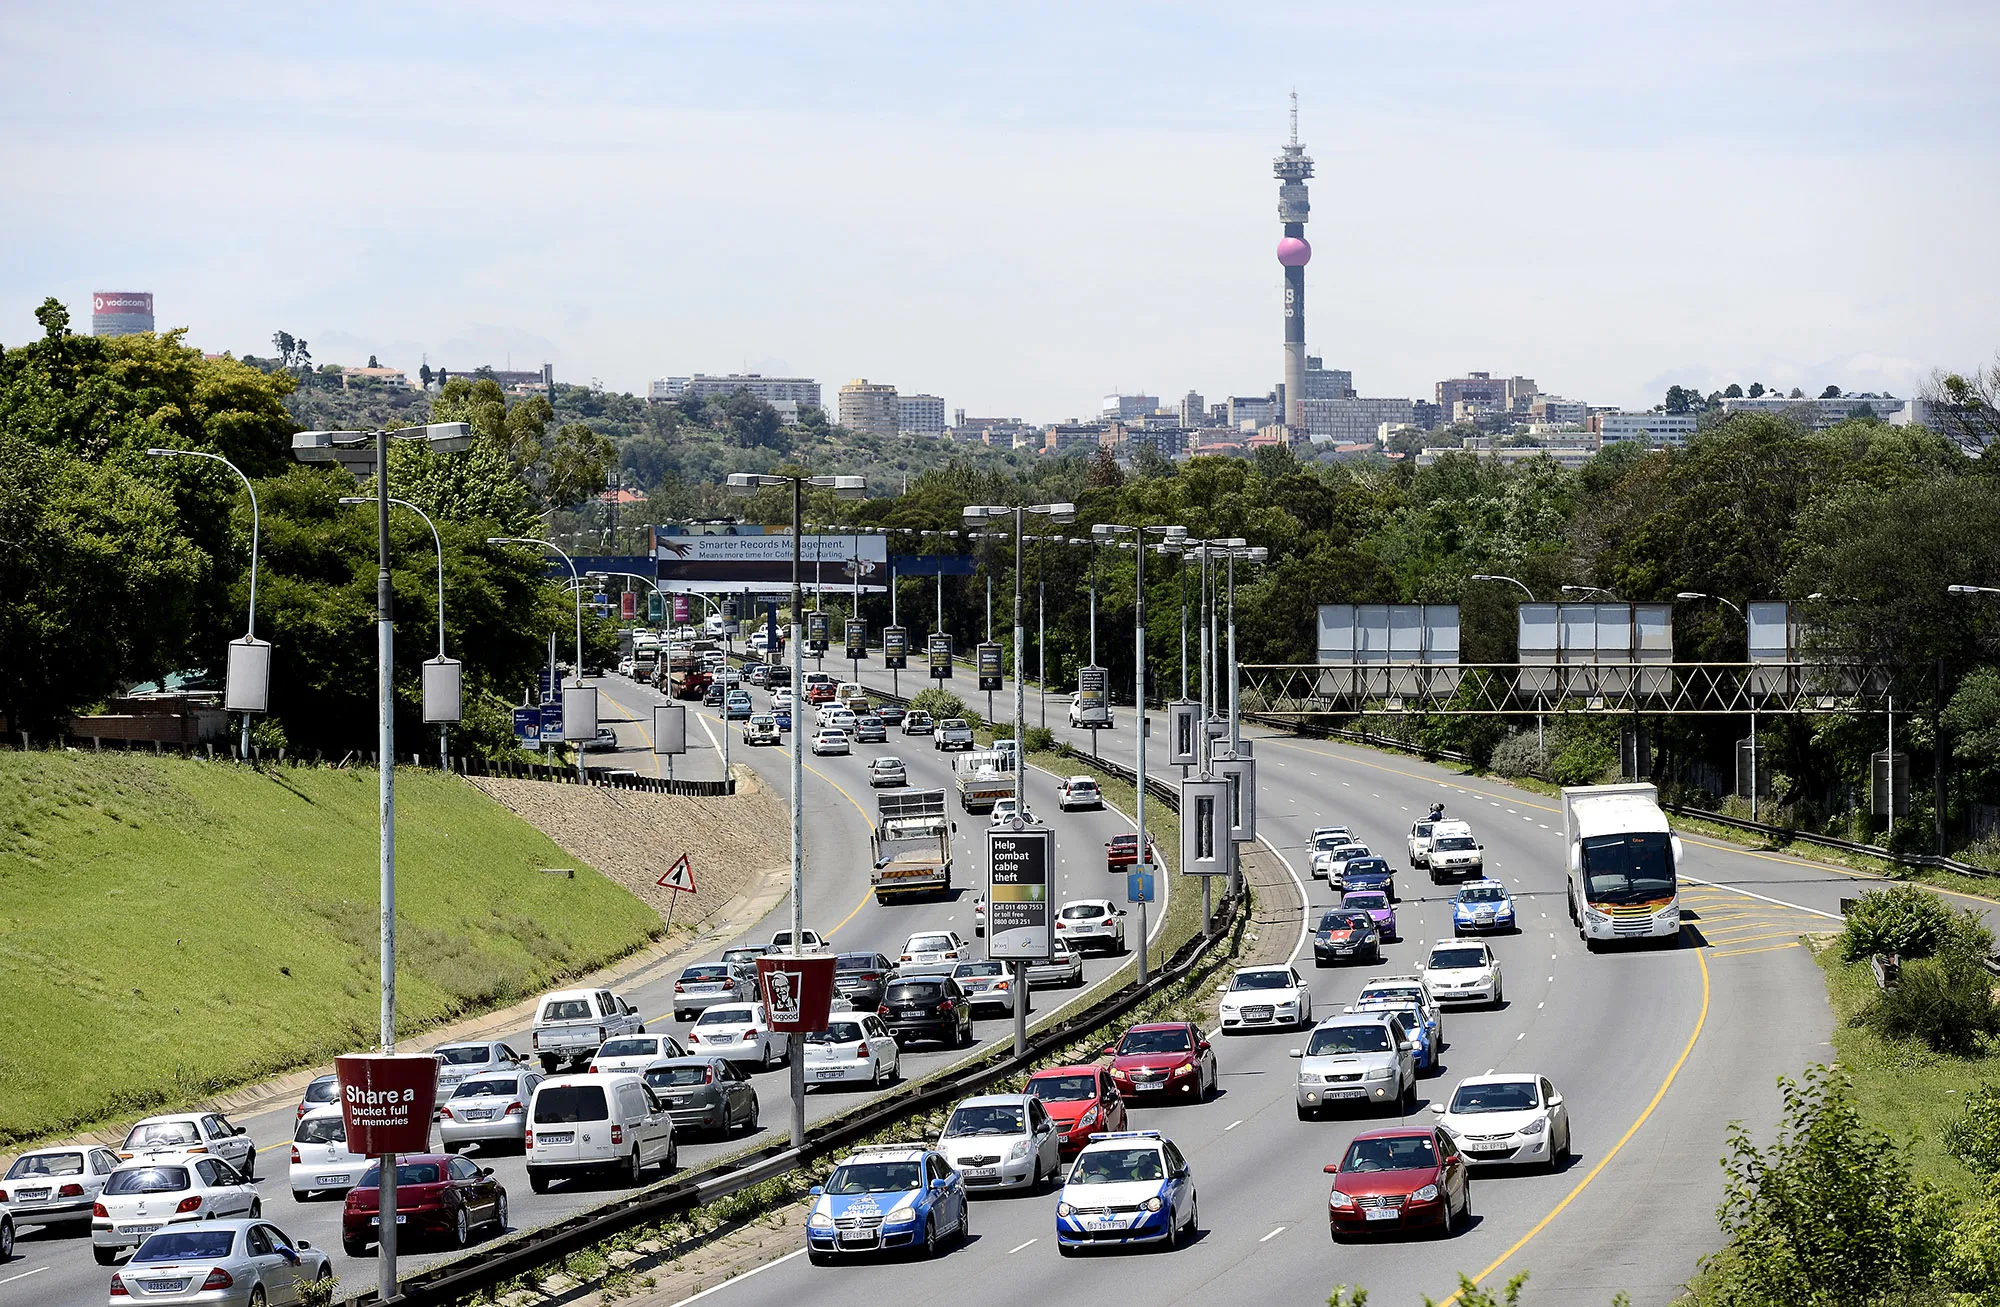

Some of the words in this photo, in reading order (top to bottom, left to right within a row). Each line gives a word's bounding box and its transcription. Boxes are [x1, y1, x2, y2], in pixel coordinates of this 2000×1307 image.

[106, 298, 145, 307] vodacom
[699, 540, 738, 549] Smarter
[740, 540, 779, 549] Records
[781, 540, 845, 550] Maagement.
[763, 551, 774, 559] for
[800, 551, 815, 559] Cup
[994, 841, 1016, 850] Help
[994, 851, 1030, 861] combat
[994, 862, 1019, 871] cable
[994, 873, 1018, 882] theft
[346, 1085, 399, 1104] Share
[403, 1088, 414, 1102] a
[352, 1105, 387, 1116] bucket
[390, 1105, 408, 1115] full
[352, 1117, 361, 1126] of
[362, 1117, 409, 1126] memories
